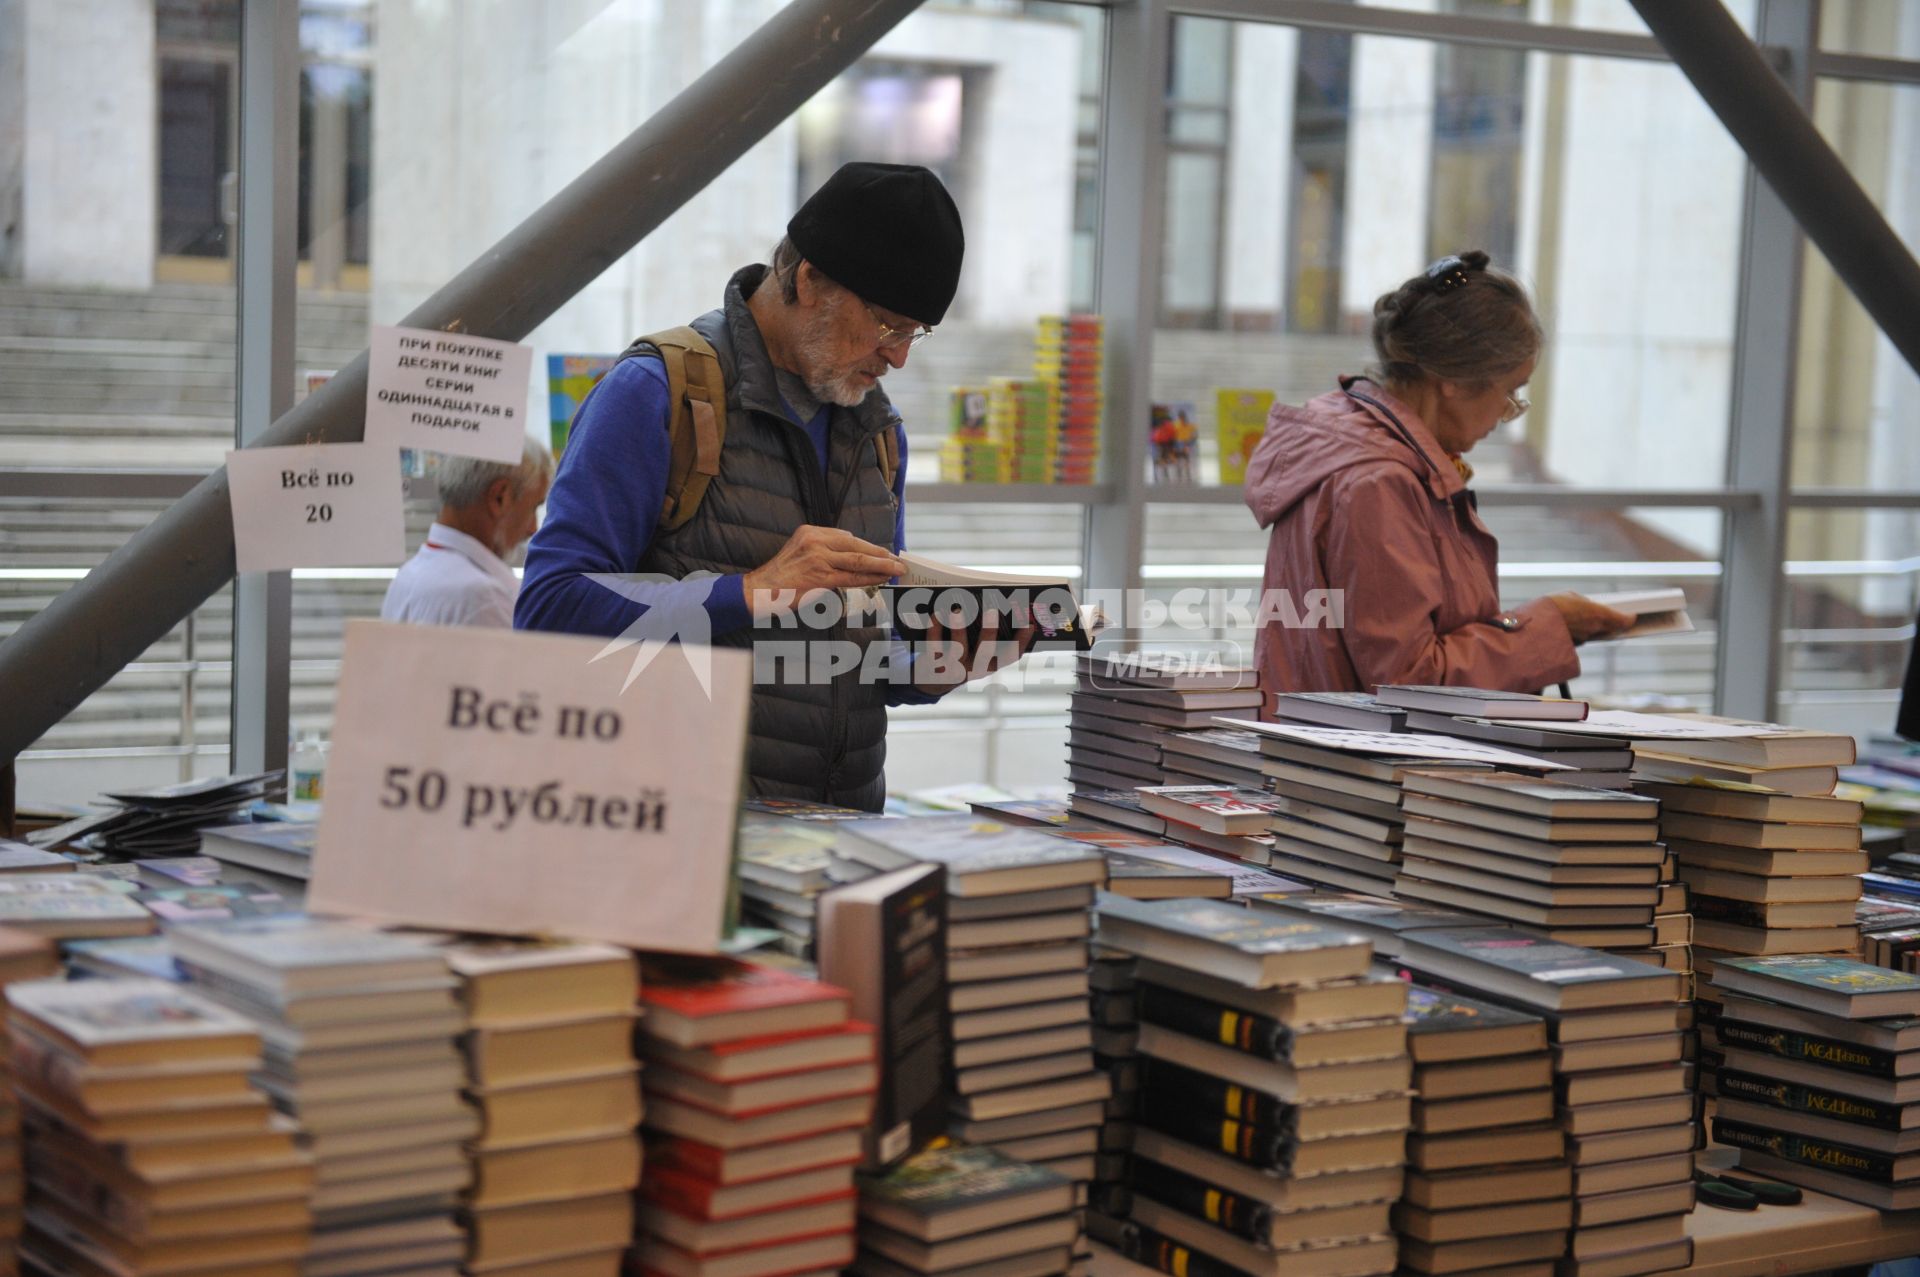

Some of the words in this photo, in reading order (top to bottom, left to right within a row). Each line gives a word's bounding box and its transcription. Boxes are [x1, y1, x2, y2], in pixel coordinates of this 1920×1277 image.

[400, 337, 431, 350] ПРИ
[436, 341, 504, 360] ПОКУПКЕ
[398, 355, 459, 373] ДЕСЯТИ
[464, 363, 503, 378] КНИГ
[425, 377, 475, 393] СЕРИИ
[377, 388, 501, 416] ОДИННАДЦАТАЯ
[504, 407, 514, 418] В
[411, 412, 481, 432] ПОДАРОК
[281, 468, 320, 489] Всё
[326, 473, 354, 487] по
[305, 504, 333, 523] 20
[446, 685, 540, 735] Всё
[556, 704, 623, 742] по
[381, 766, 447, 813] 50
[462, 779, 668, 833] рублей
